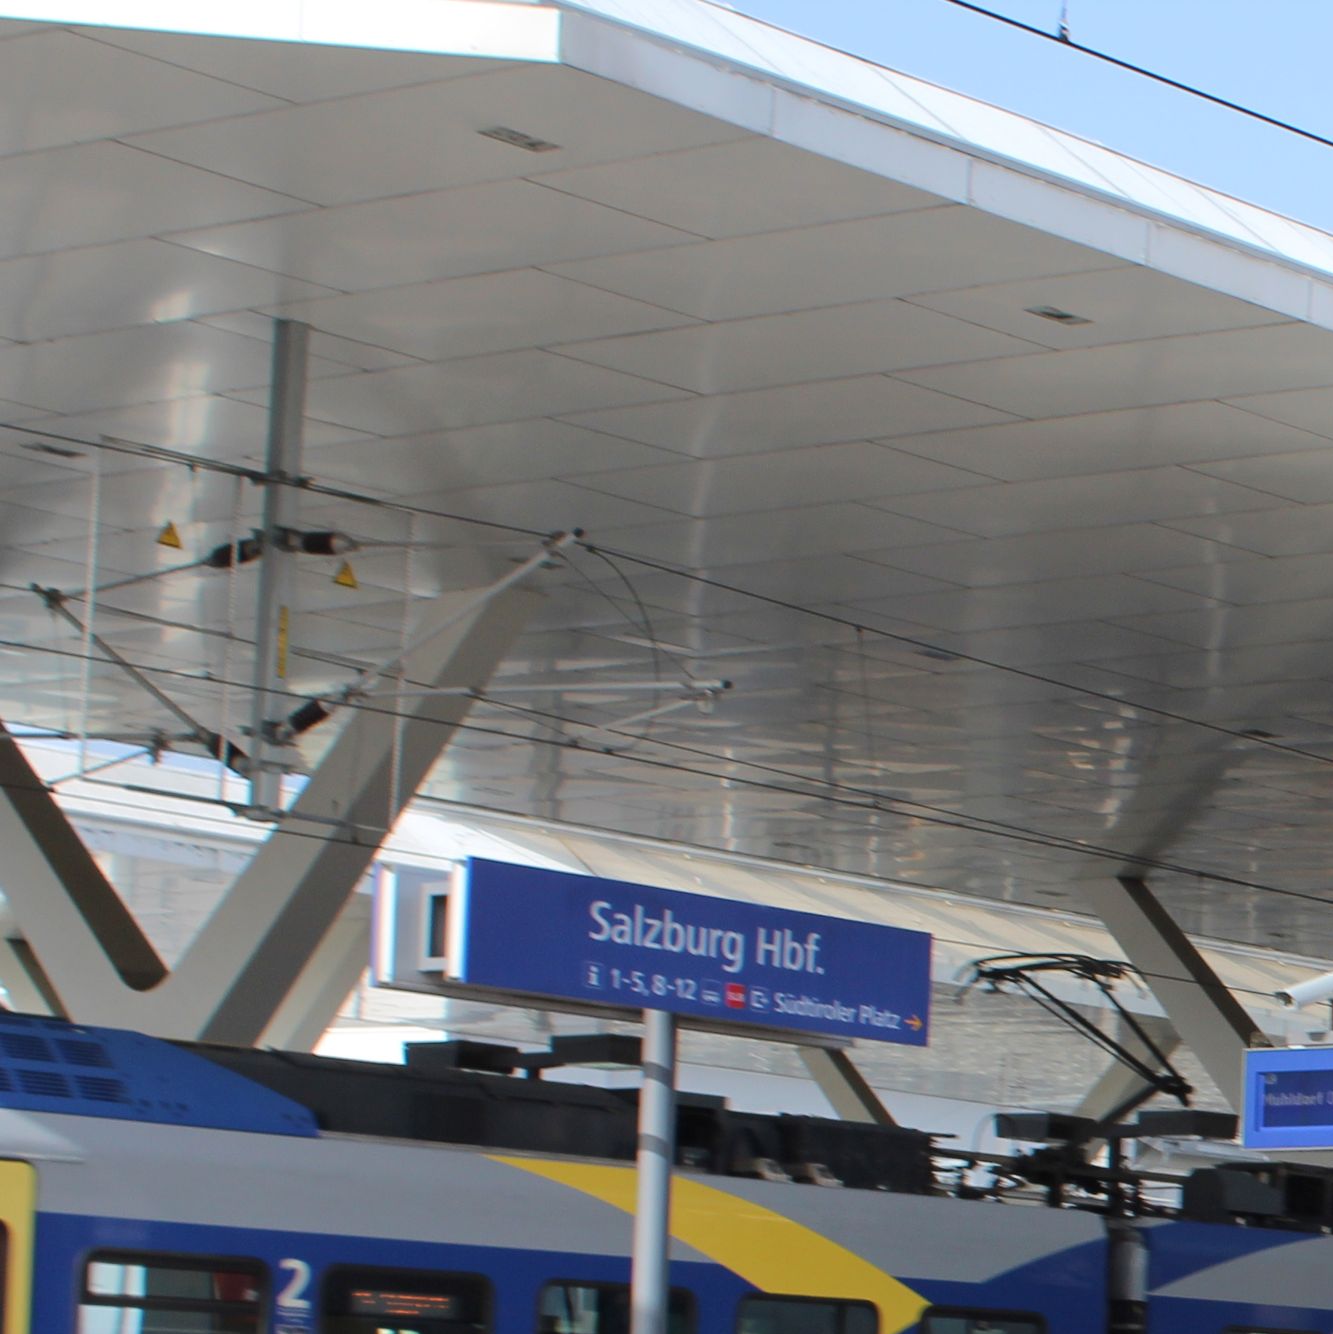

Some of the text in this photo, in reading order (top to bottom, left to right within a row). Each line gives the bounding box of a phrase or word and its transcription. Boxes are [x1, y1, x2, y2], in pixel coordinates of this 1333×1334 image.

[588, 900, 826, 975] Salzburg Hbf.
[859, 1004, 901, 1030] Platz
[276, 1257, 312, 1309] 2
